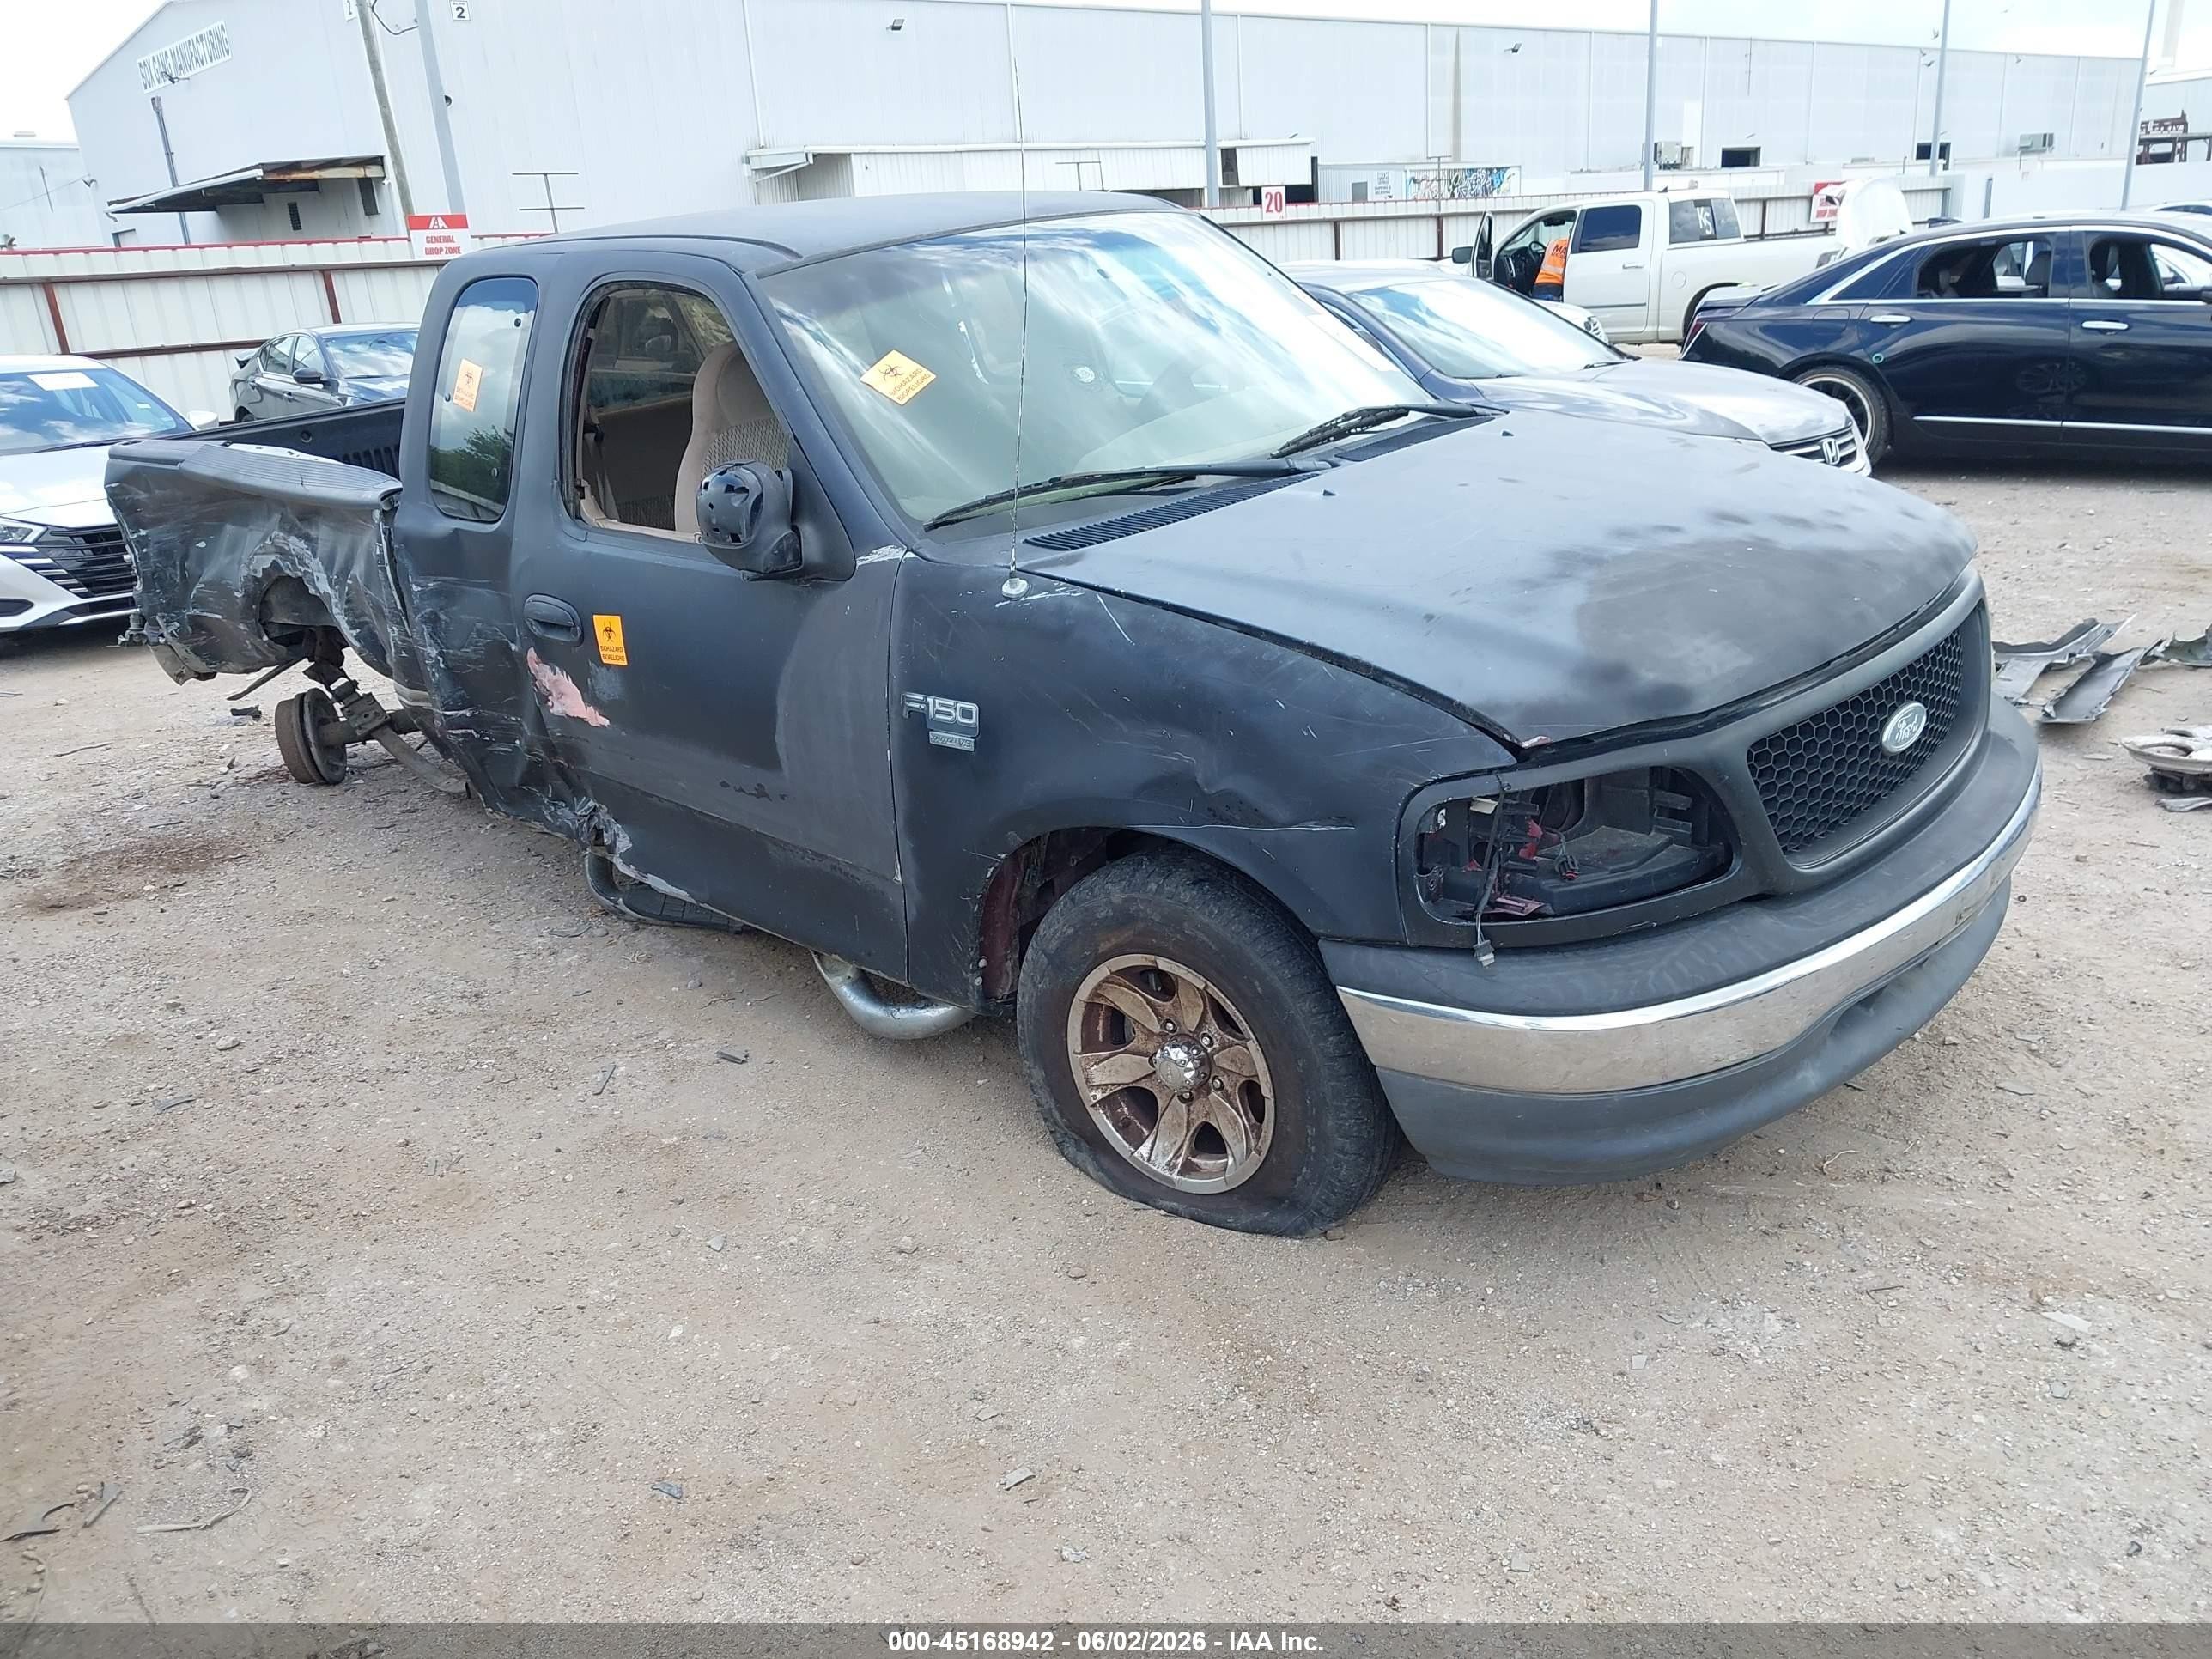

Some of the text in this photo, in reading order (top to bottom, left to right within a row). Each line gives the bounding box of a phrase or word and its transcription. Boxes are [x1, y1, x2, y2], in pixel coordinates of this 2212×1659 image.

[456, 6, 465, 19] 2
[138, 58, 156, 90] BOX
[169, 24, 229, 76] MANUFACTURING
[1265, 191, 1283, 213] 20
[425, 235, 455, 244] GENERAL
[424, 246, 462, 256] DROP ZONE
[887, 368, 922, 396] BIOHAZARD
